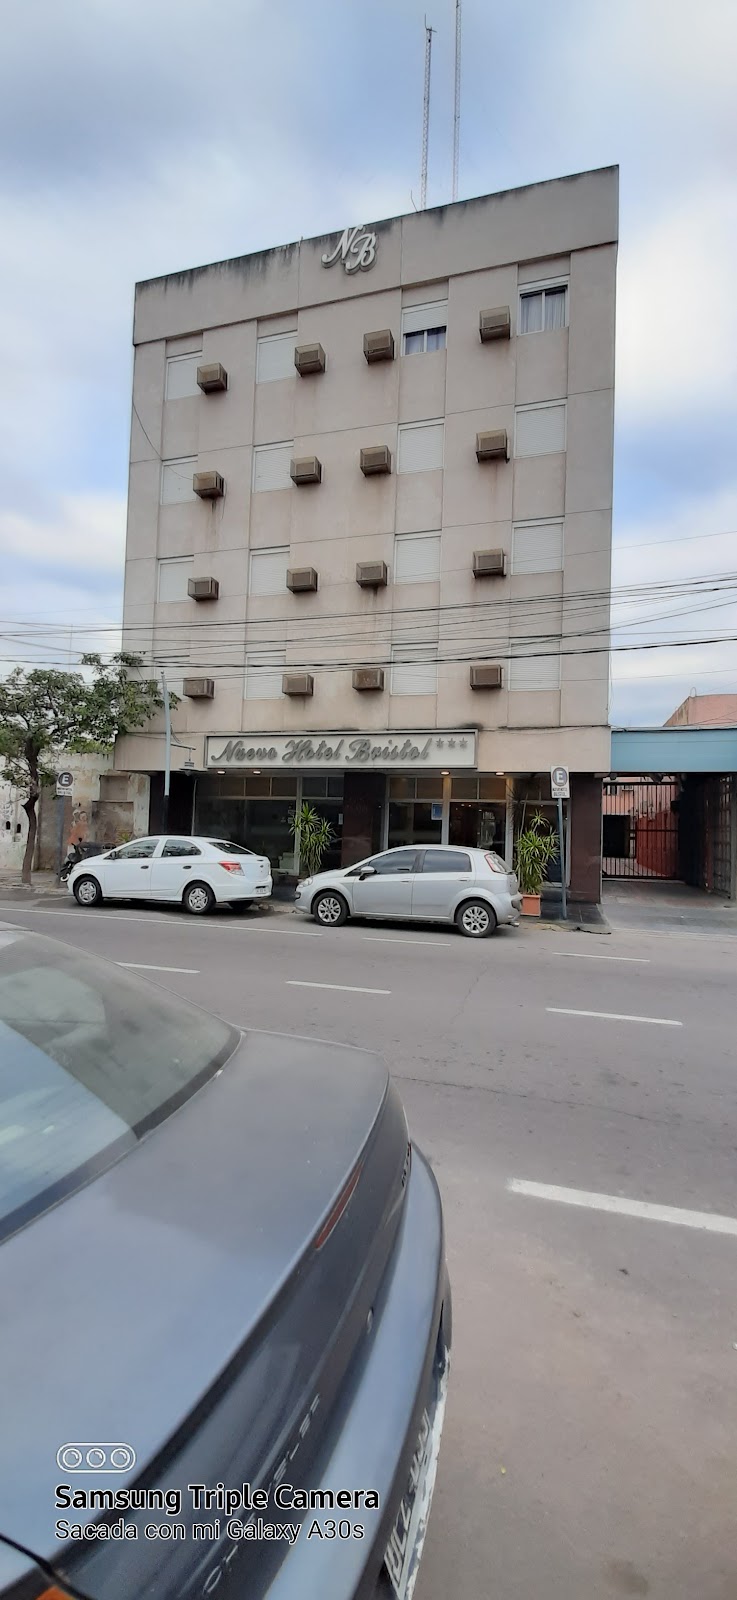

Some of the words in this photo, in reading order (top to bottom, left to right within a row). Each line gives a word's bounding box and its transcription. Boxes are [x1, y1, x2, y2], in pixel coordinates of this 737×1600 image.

[321, 224, 377, 274] NB
[211, 739, 278, 762] Nuevo
[281, 738, 344, 763] Hotel
[345, 738, 432, 763] Bristol
[62, 774, 70, 784] E
